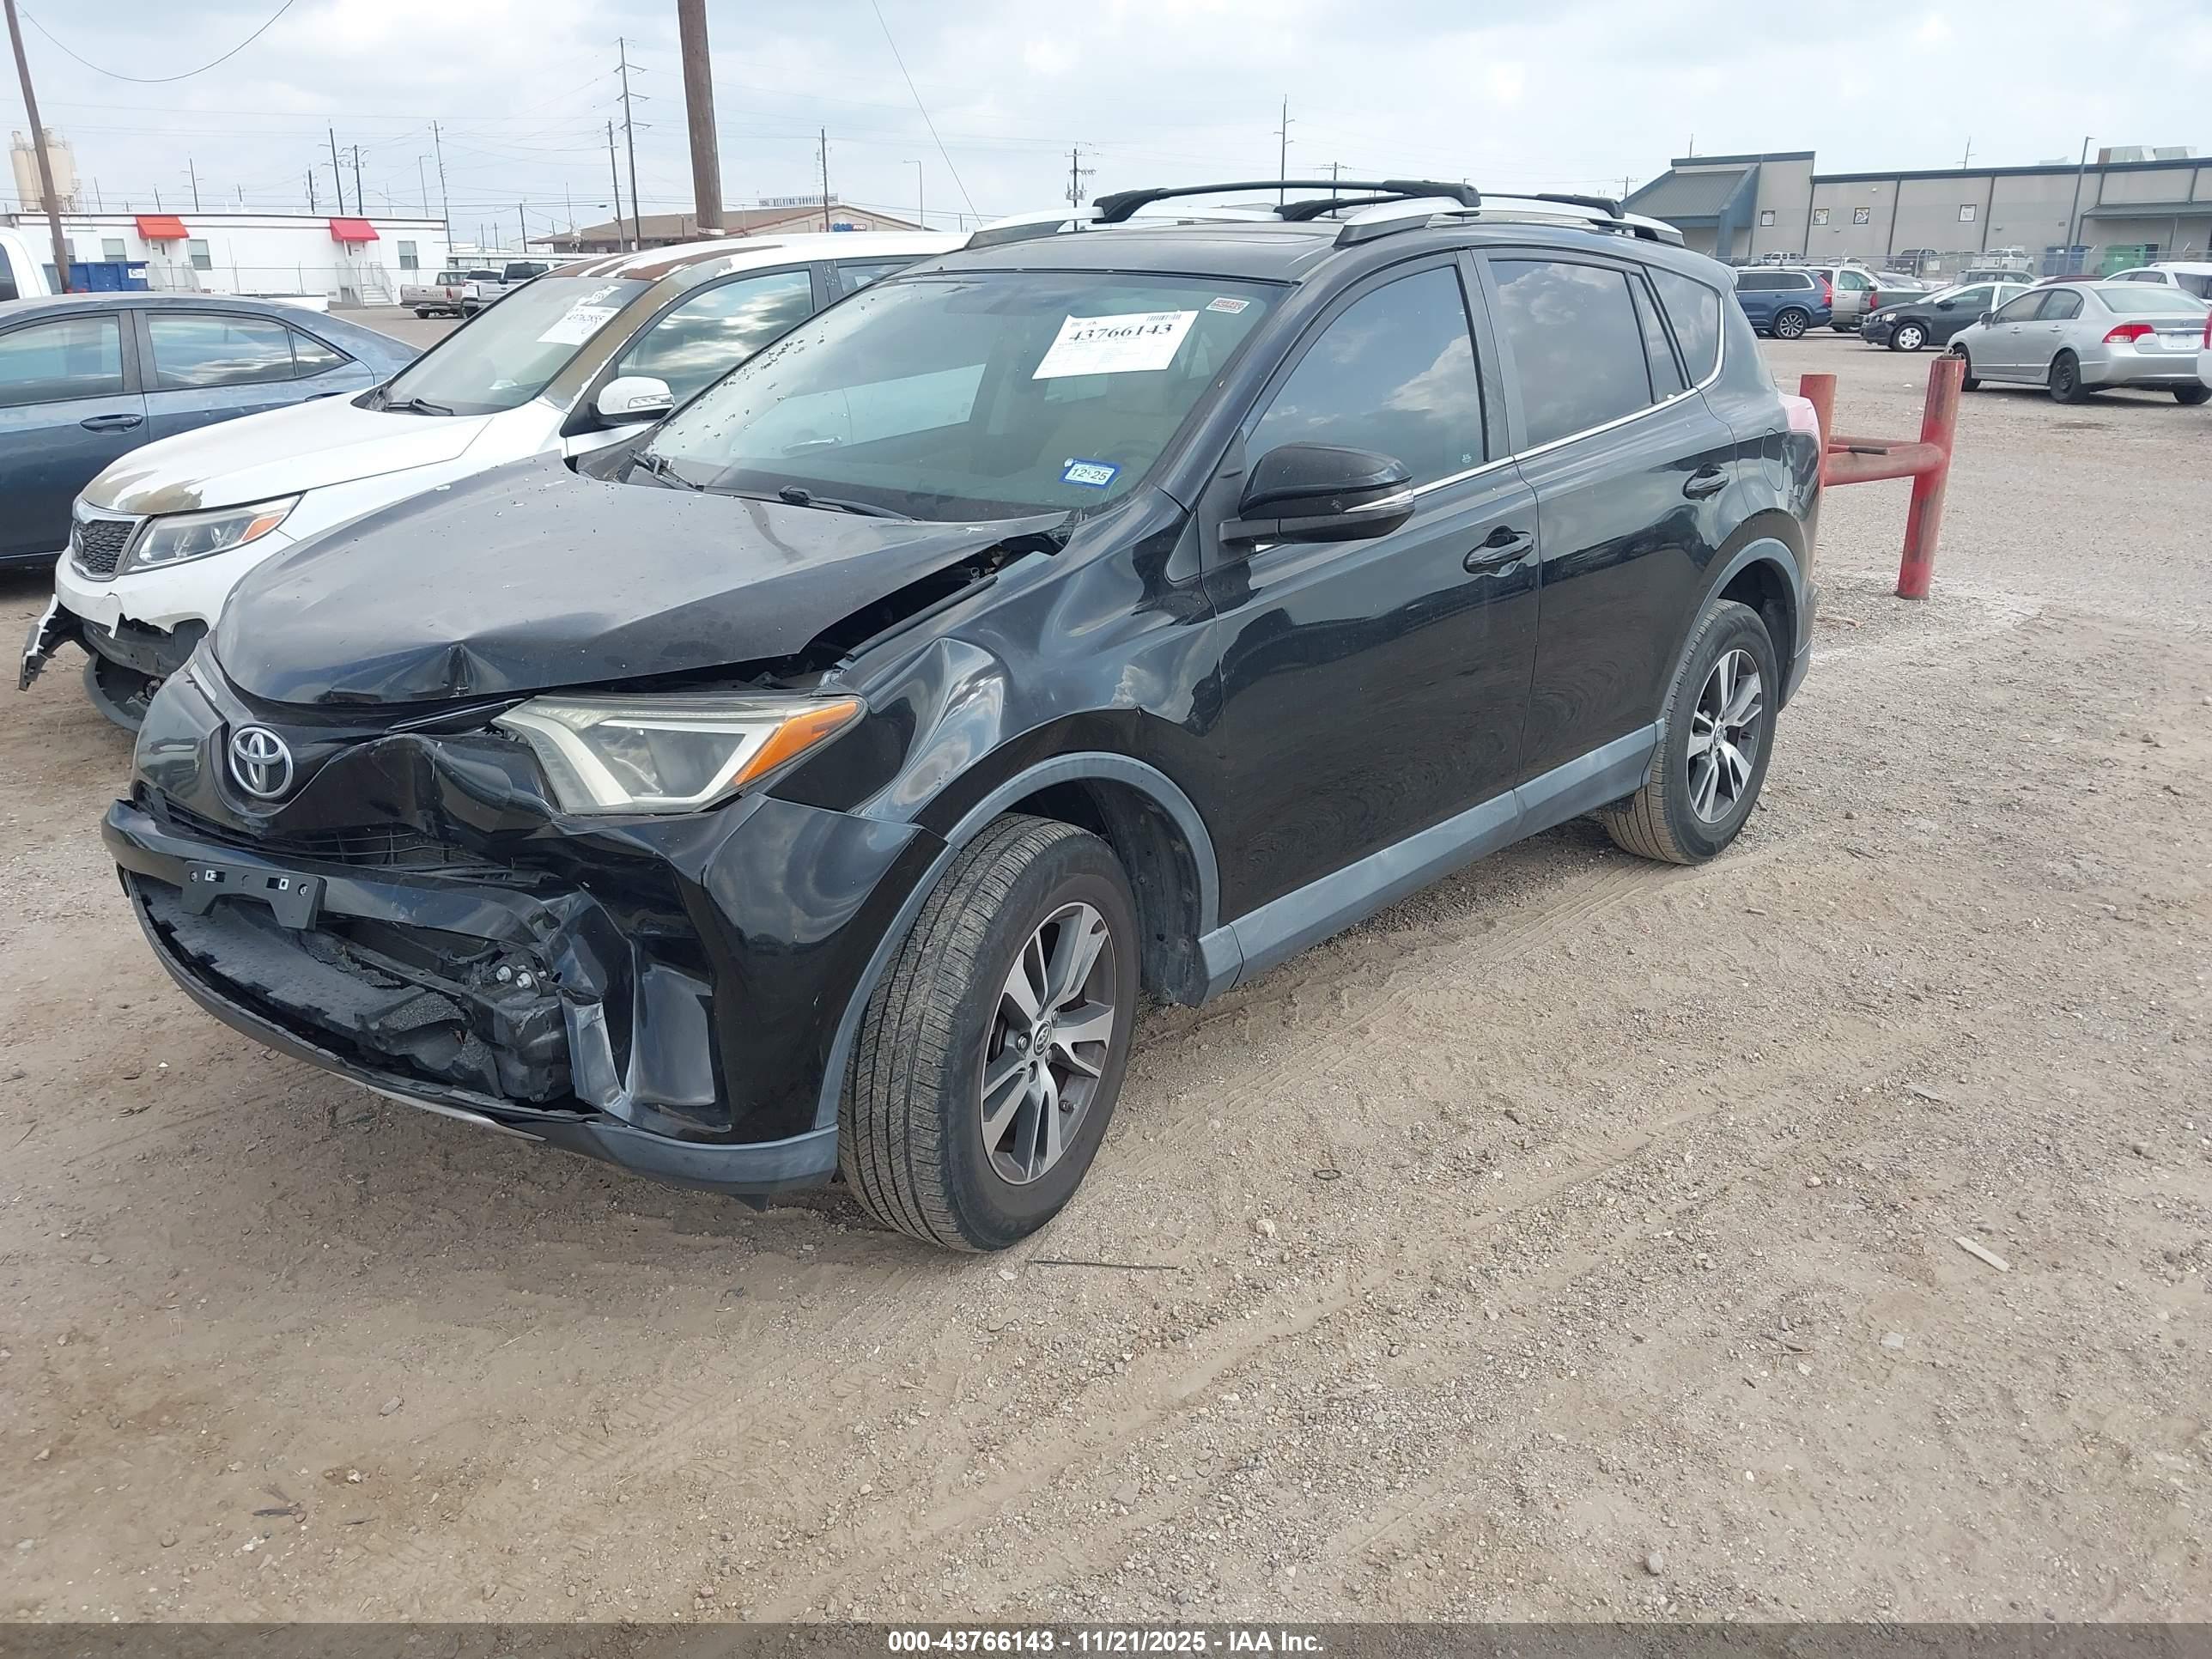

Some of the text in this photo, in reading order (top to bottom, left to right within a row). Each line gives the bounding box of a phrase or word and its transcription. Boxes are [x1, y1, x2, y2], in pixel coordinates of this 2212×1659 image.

[1068, 324, 1173, 341] 43766143
[1072, 468, 1109, 481] 12 25
